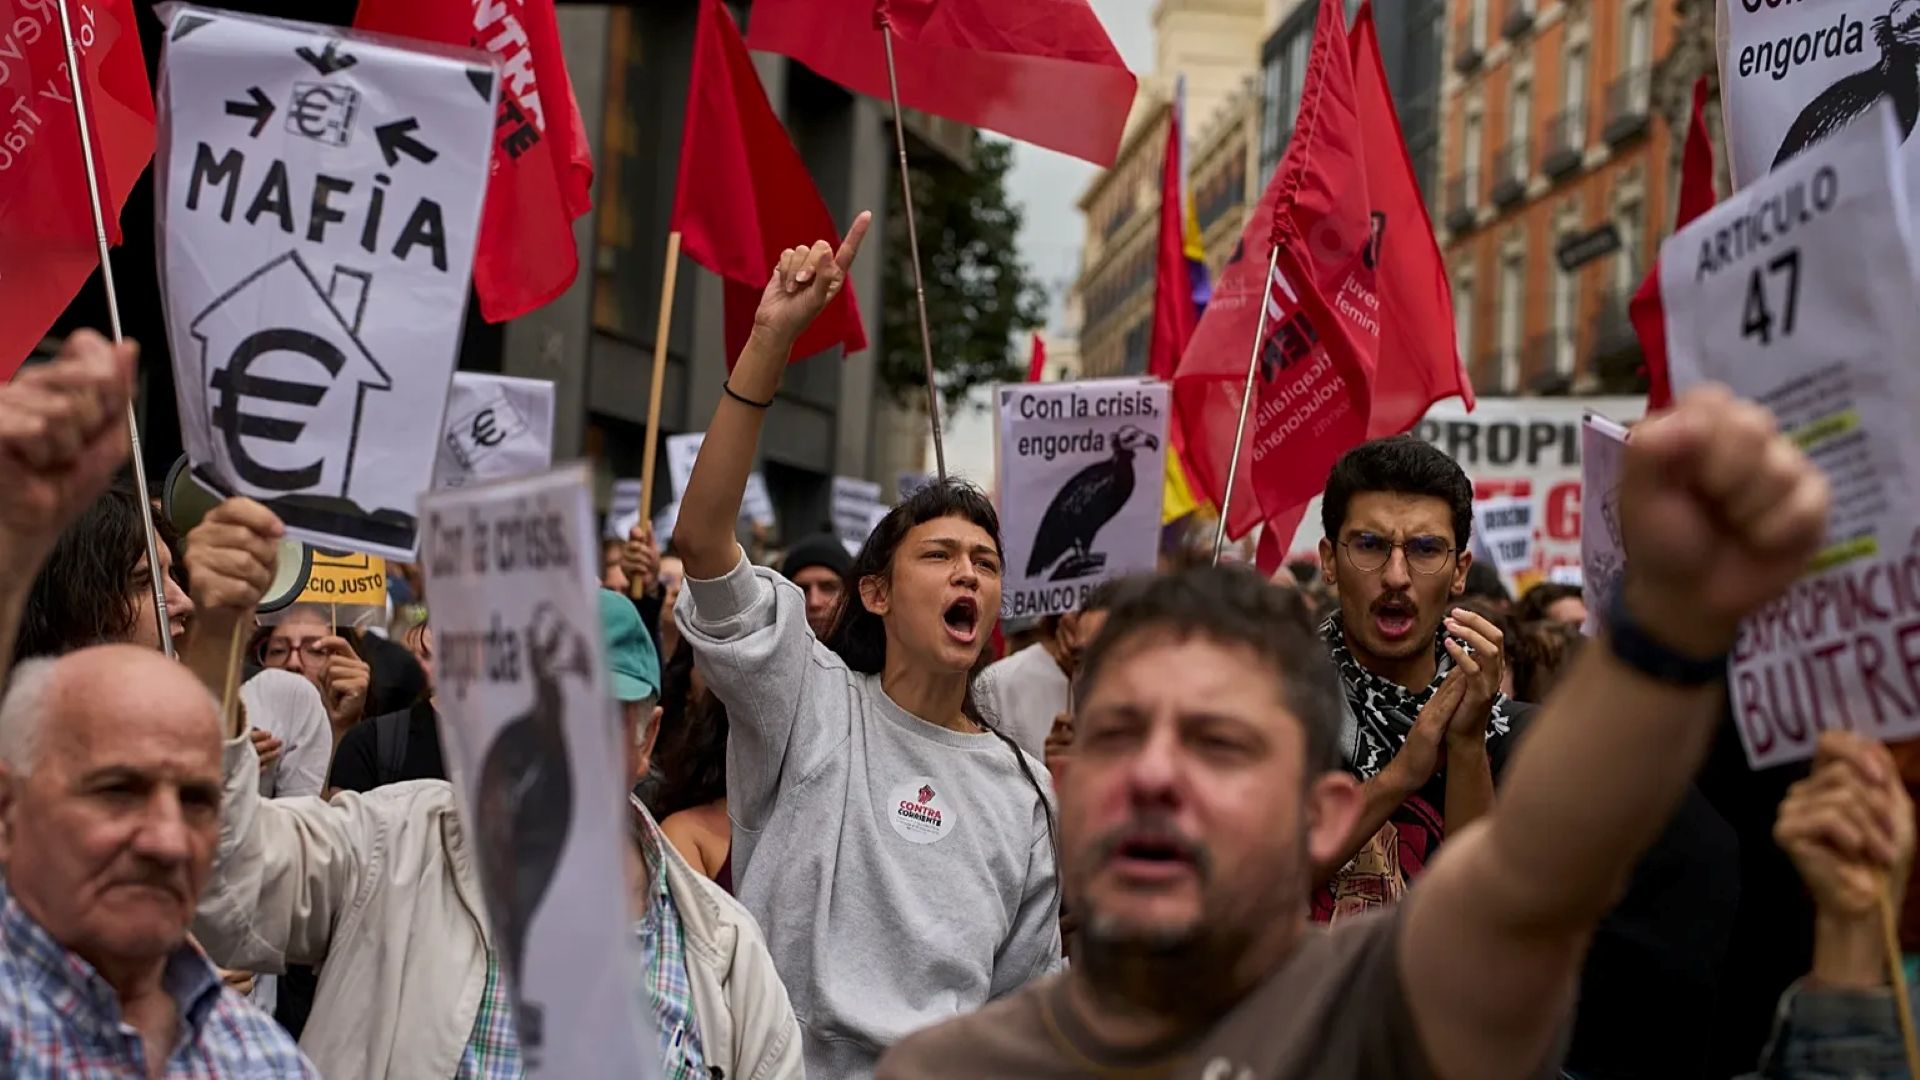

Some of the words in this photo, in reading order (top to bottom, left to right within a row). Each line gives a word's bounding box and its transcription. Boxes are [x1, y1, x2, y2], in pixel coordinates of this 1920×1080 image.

[1739, 14, 1863, 81] engorda
[1741, 247, 1801, 346] 47
[1020, 394, 1062, 419] Con
[1071, 394, 1088, 417] la
[1096, 391, 1158, 418] crisis,
[1018, 429, 1104, 461] engorda
[306, 577, 336, 594] CIO
[339, 574, 383, 594] JUSTO
[1014, 586, 1075, 616] BANCO
[898, 808, 942, 827] CORRIENTE
[900, 800, 941, 819] CONTRA
